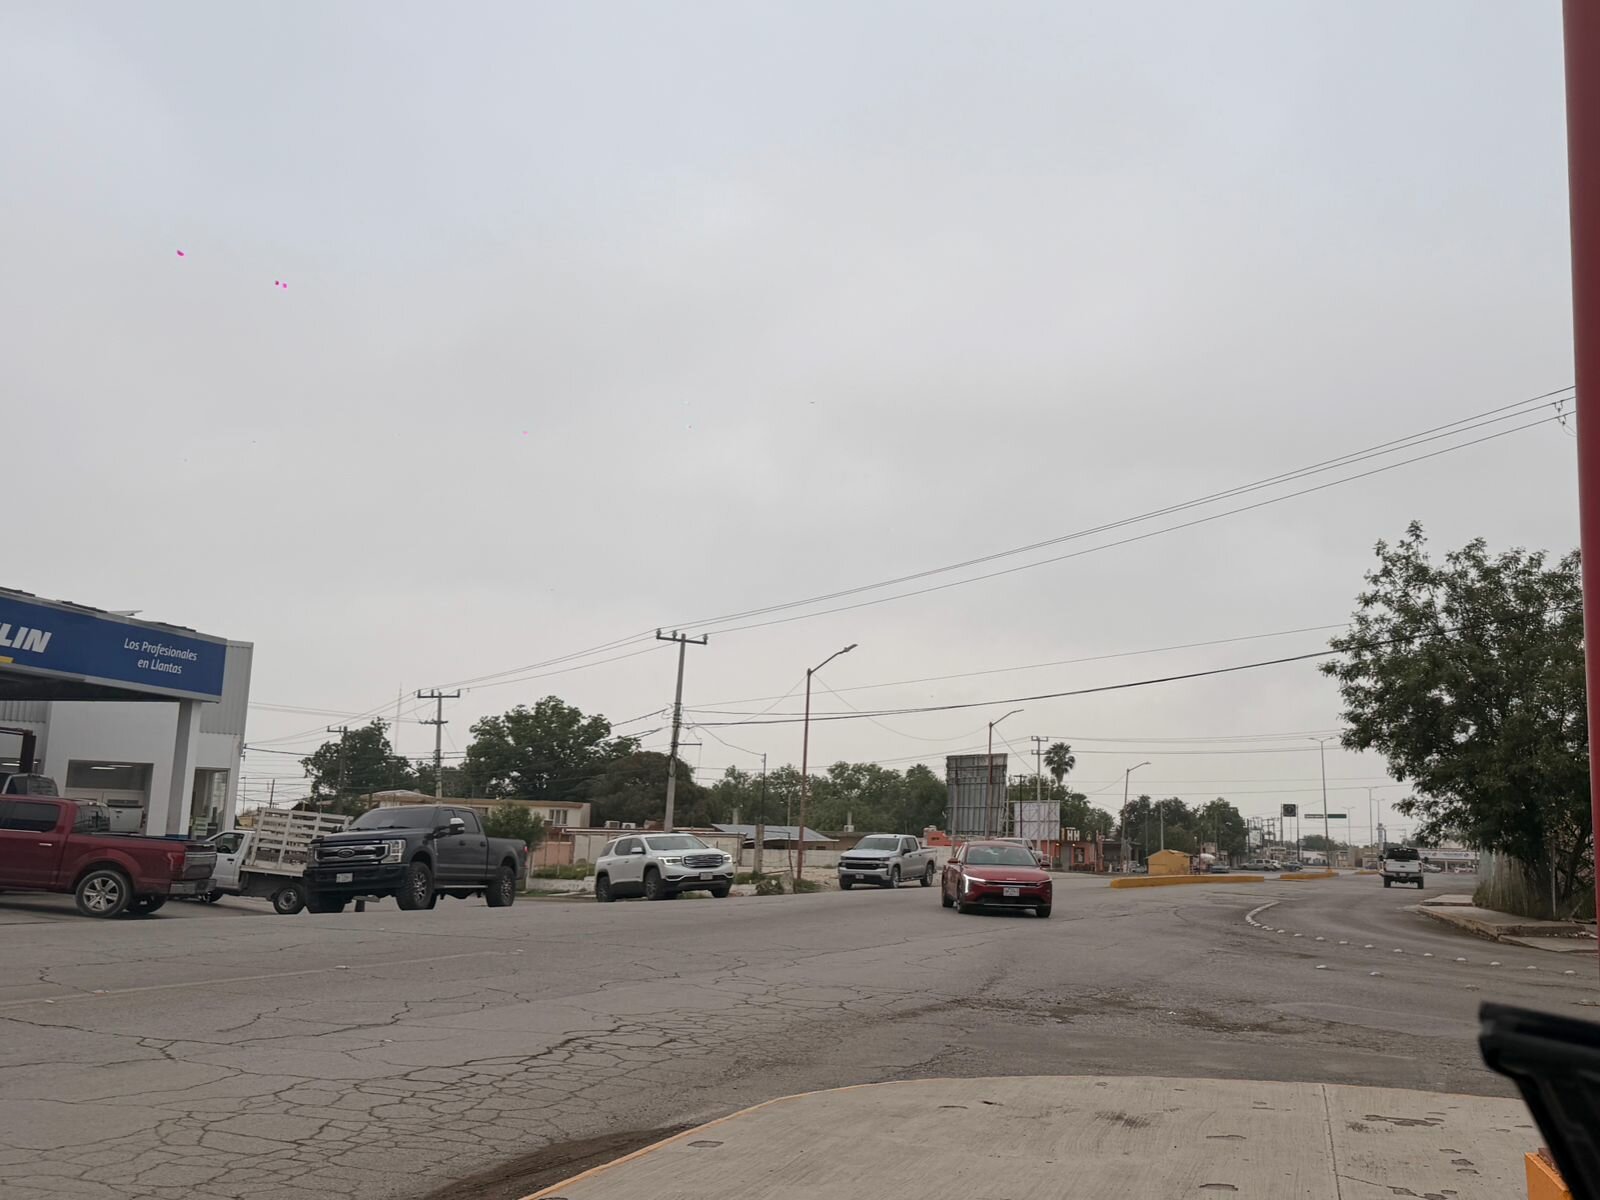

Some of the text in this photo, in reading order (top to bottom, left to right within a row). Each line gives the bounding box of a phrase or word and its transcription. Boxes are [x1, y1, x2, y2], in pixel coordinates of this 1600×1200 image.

[0, 622, 52, 653] LIN
[124, 638, 198, 661] Los Profesionales
[137, 659, 182, 674] en Llantas
